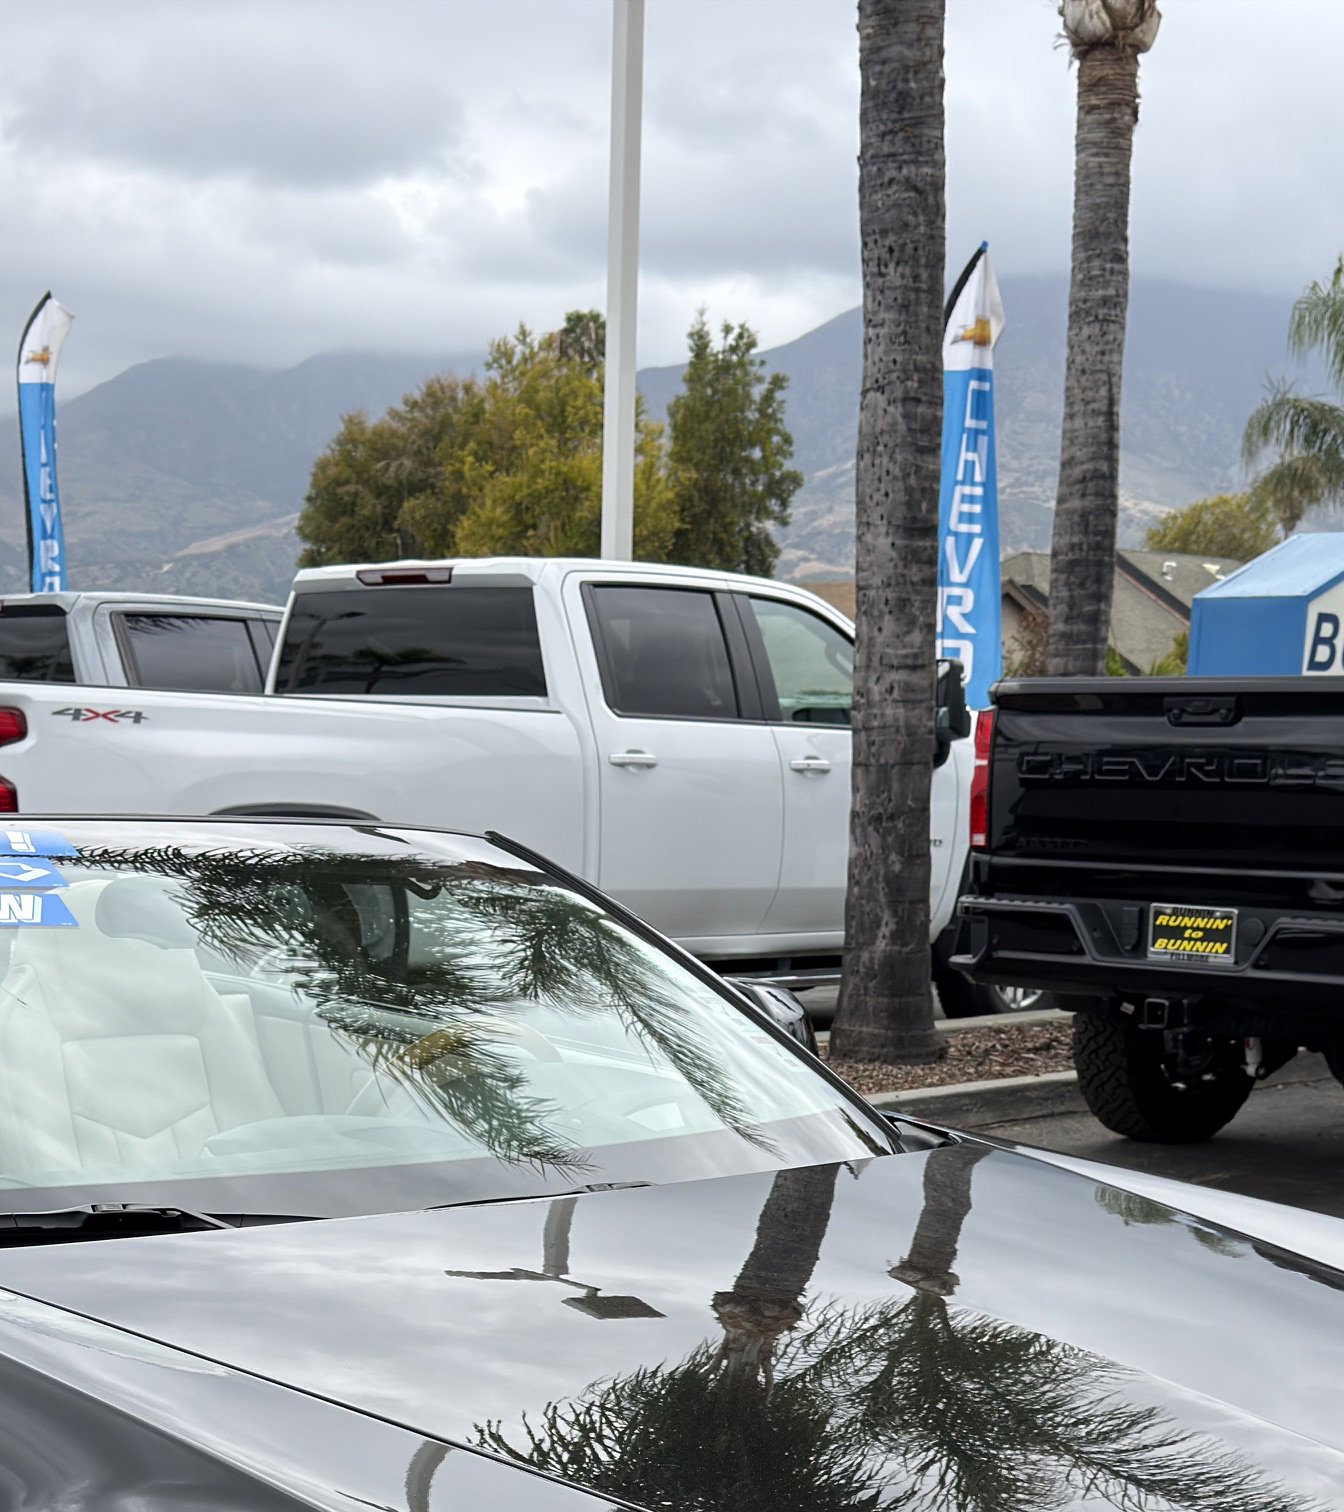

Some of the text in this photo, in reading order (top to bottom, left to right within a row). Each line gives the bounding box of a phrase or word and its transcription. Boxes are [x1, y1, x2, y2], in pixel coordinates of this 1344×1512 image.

[52, 707, 150, 724] 4X4
[1155, 914, 1233, 930] RUNNIN'
[1183, 928, 1205, 939] to
[1153, 938, 1228, 954] BUNNIN
